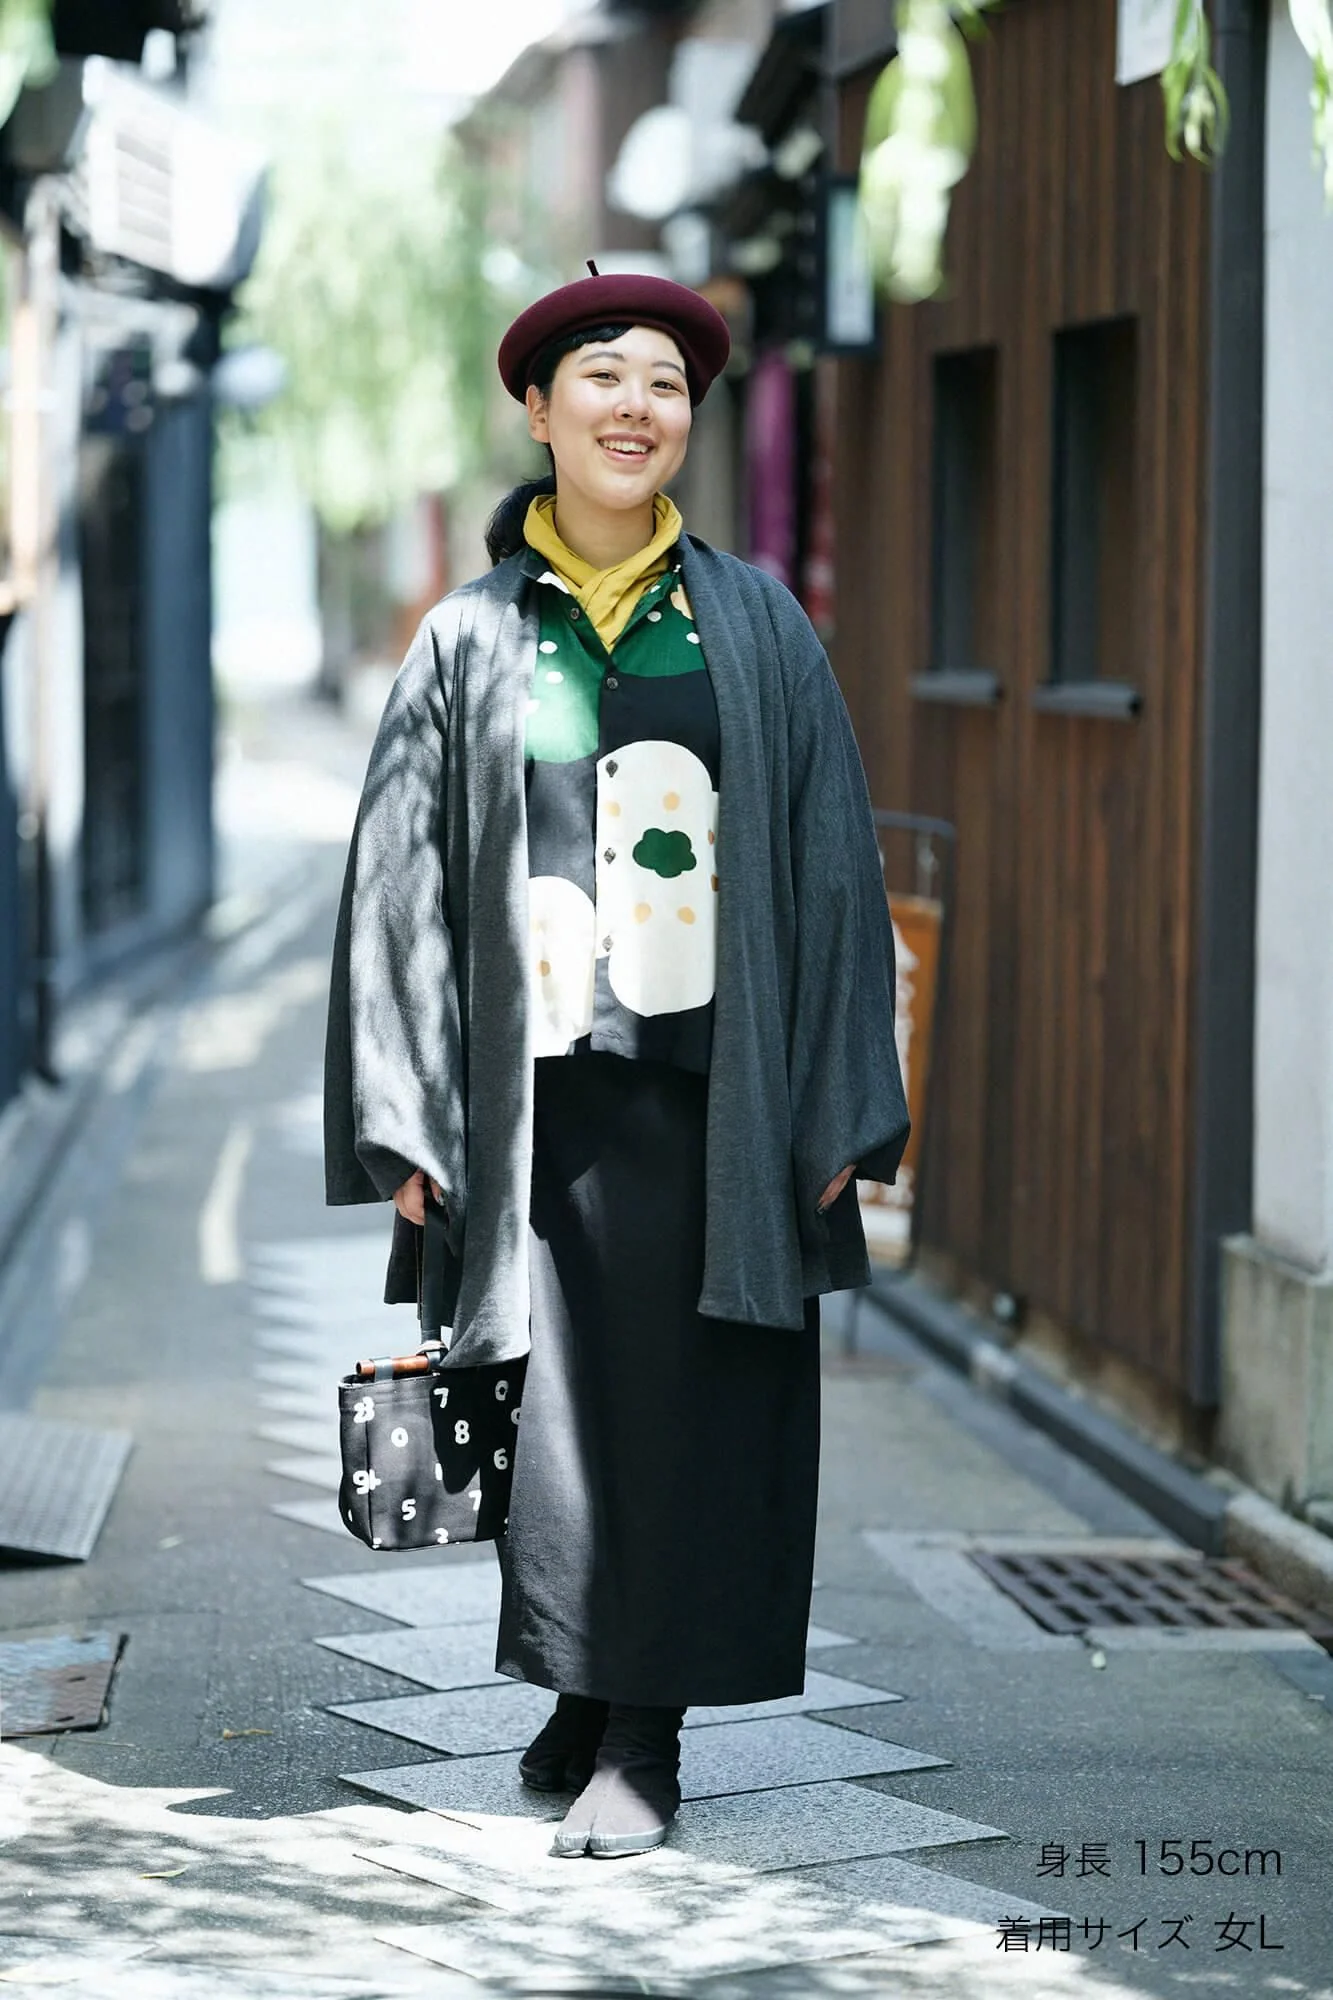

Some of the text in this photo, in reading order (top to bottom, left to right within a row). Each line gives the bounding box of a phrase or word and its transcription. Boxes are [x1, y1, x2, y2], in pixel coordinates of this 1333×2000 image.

[433, 1387, 449, 1408] 7
[390, 1427, 409, 1447] 0
[454, 1419, 470, 1445] 8
[493, 1448, 508, 1470] 6
[401, 1498, 417, 1521] 5
[468, 1489, 482, 1511] 7
